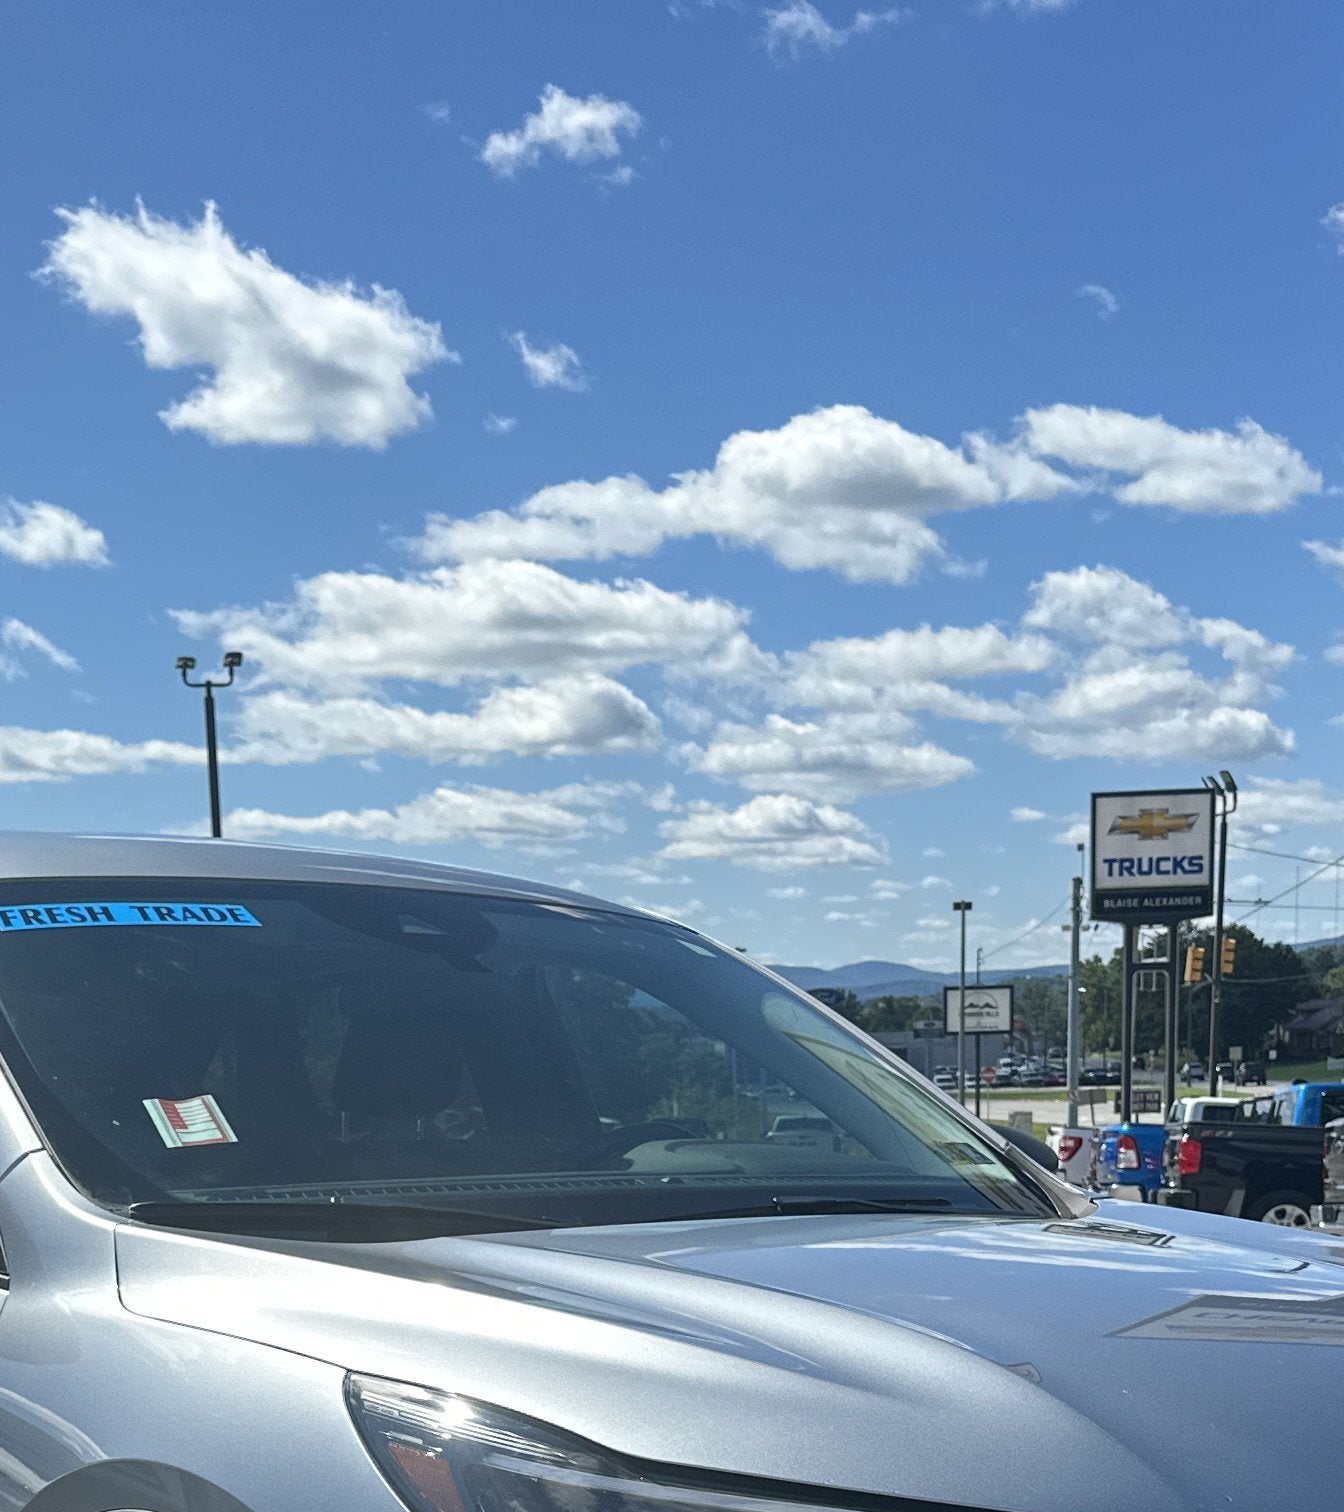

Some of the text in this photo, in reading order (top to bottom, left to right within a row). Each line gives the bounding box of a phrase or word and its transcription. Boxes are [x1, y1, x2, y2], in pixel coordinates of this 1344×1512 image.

[1102, 855, 1204, 877] TRUCKS
[1103, 896, 1202, 908] BLAISE ALEXANDER
[129, 905, 252, 923] TRADE
